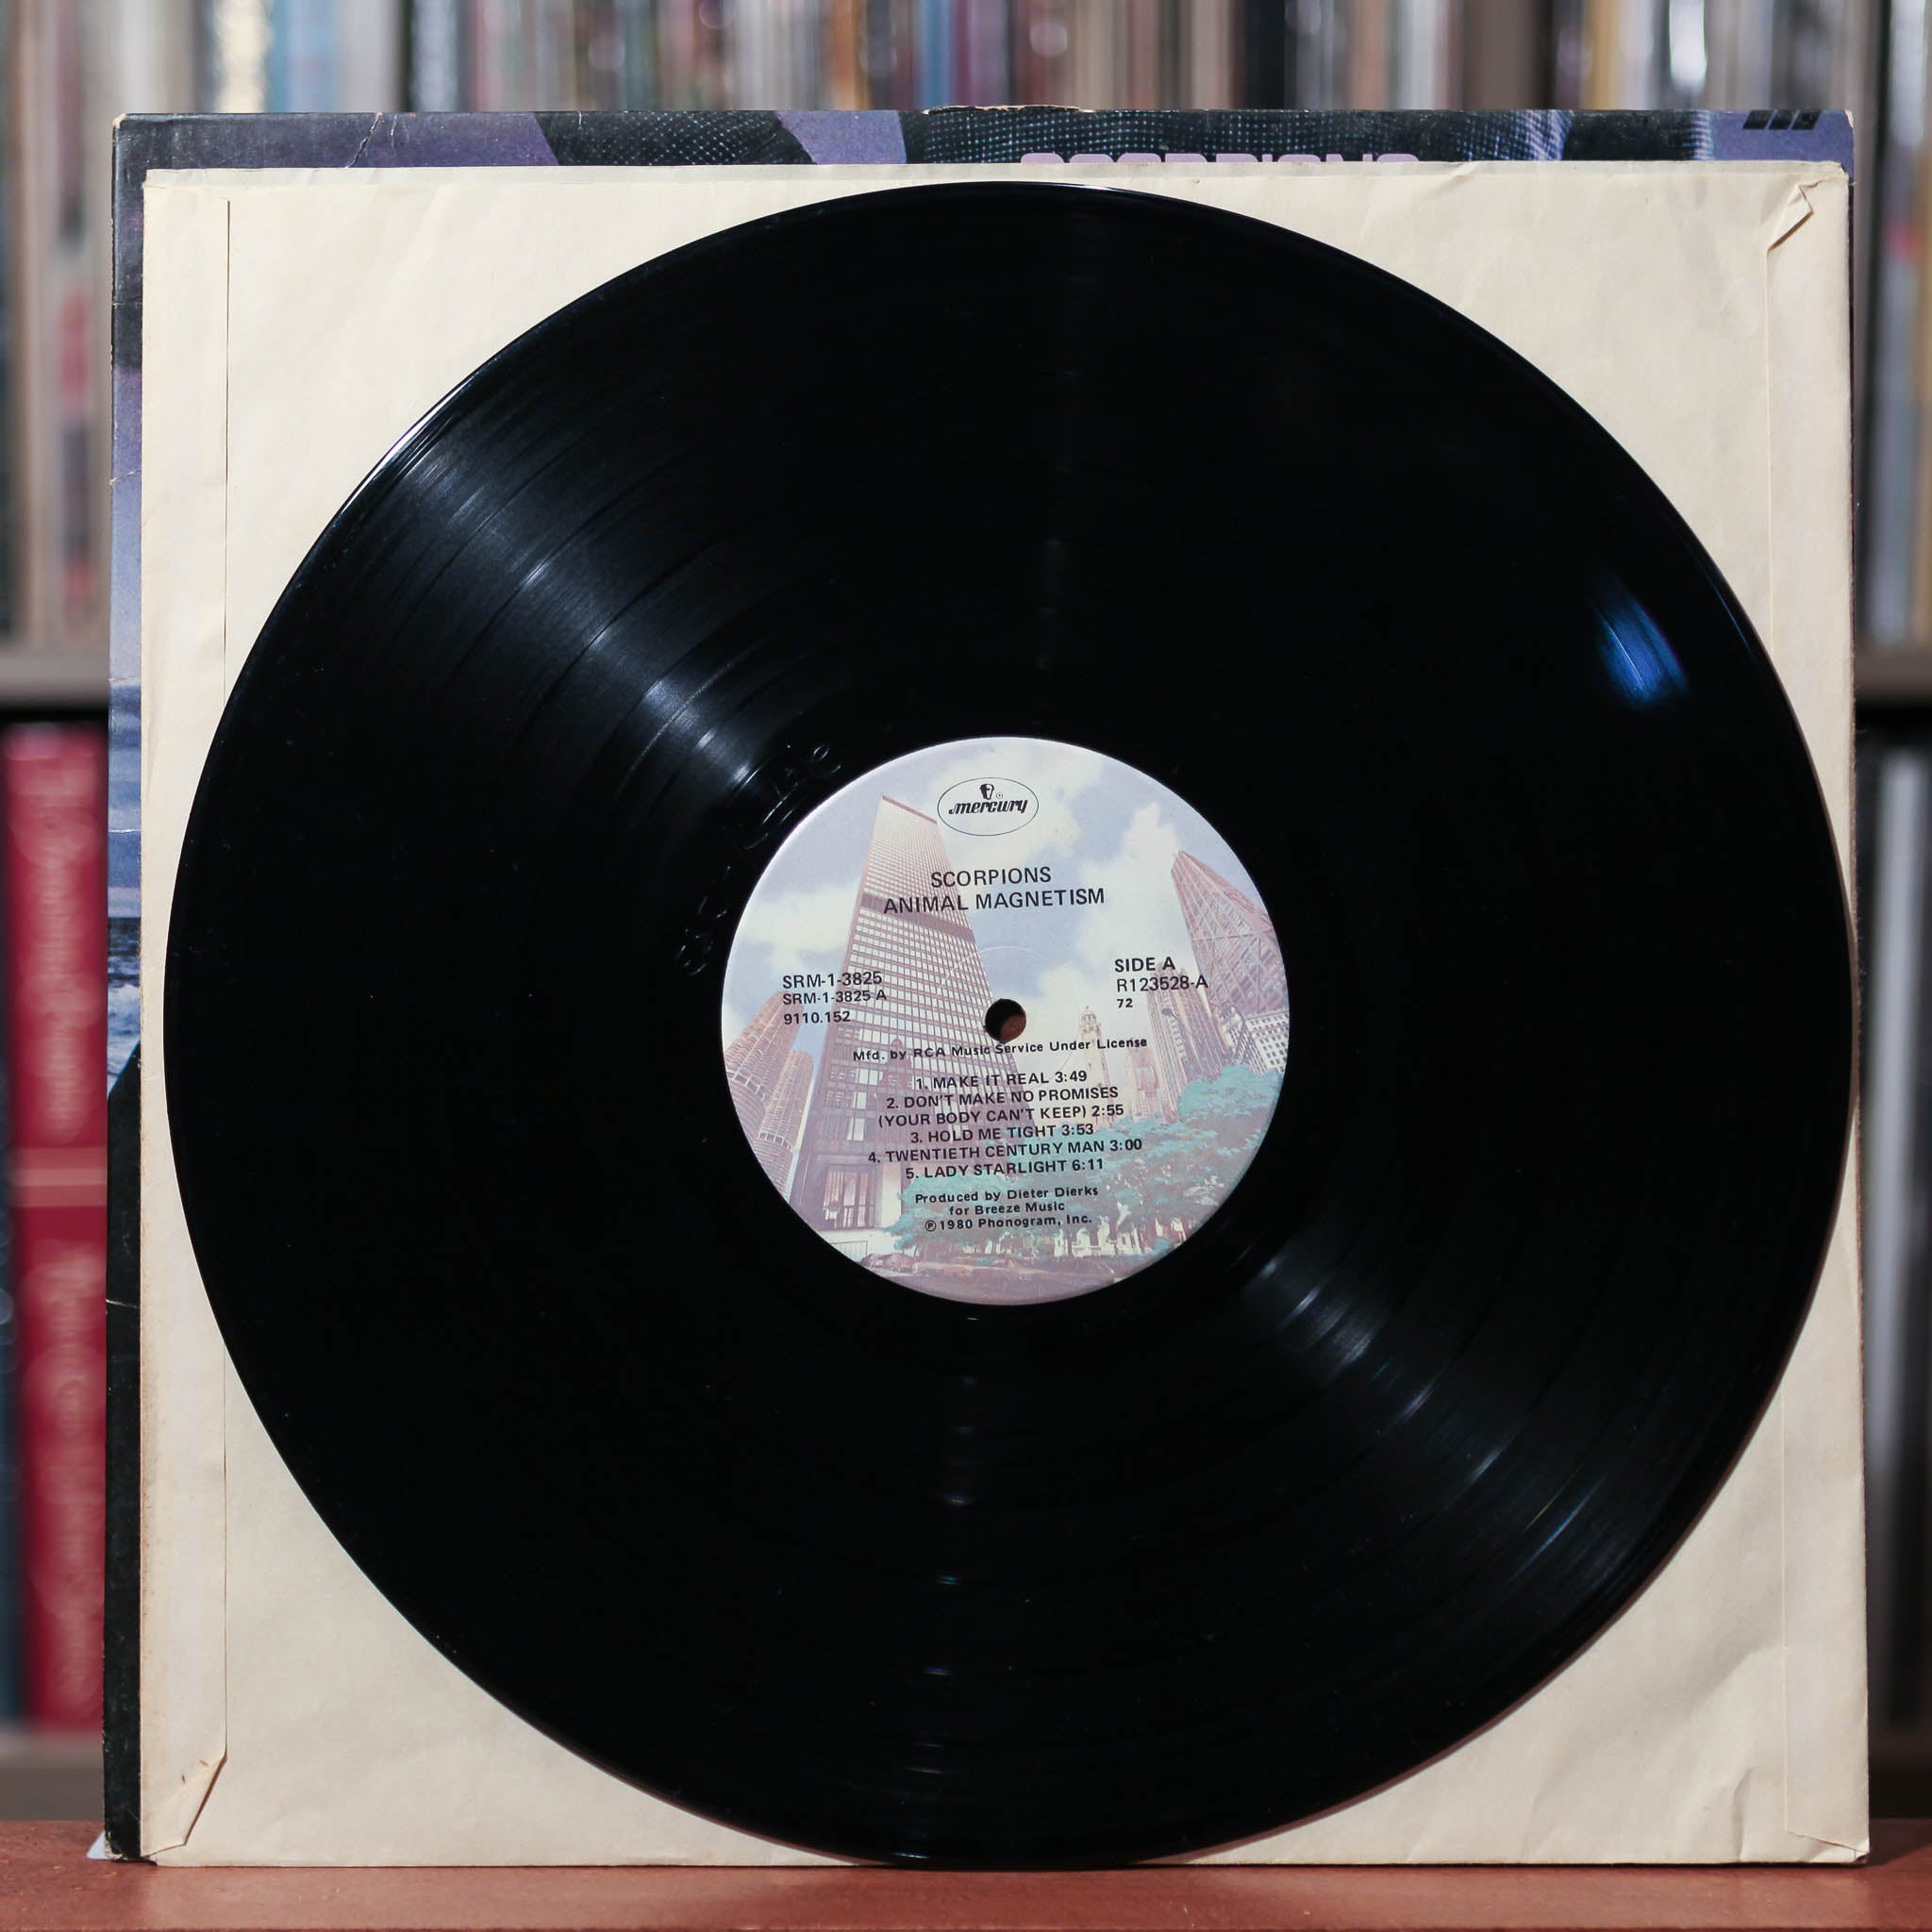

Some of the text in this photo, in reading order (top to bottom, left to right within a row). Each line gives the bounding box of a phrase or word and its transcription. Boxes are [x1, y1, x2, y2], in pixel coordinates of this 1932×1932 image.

[948, 799, 1028, 814] mercury
[930, 866, 1052, 888] SCORPIONS
[883, 888, 1105, 914] ANIMAL MAGNETISM
[1115, 957, 1175, 973] SIDE A
[782, 971, 883, 989] SRM-1-3825
[1117, 974, 1208, 992] R123528-A
[782, 989, 887, 1006] SRM-1-3825 A
[1117, 998, 1133, 1008] 72
[783, 1010, 851, 1025] 9110.152
[853, 1039, 1147, 1061] Mfd. by RCA Music Service Under License
[916, 1070, 1087, 1090] 1. MAKE IT REAL 3:49
[887, 1086, 1119, 1109] 2. DON'T MAKE NO PROMISES
[878, 1104, 1124, 1128] (YOUR BODY CAN'T KEEP) 2:55
[910, 1124, 1093, 1143] 3. HOLD ME TIGHT 3:53
[868, 1138, 1142, 1163] 4. TWENTIETH CENTURY MAN 3:00
[906, 1158, 1103, 1179] 5. LADY STARLIGHT 6:11
[915, 1186, 1098, 1204] Produced by Dieter Dierks
[949, 1202, 1065, 1216] for Breeze Music
[978, 1217, 1061, 1228] Phonogram,
[1066, 1214, 1092, 1224] Inc.
